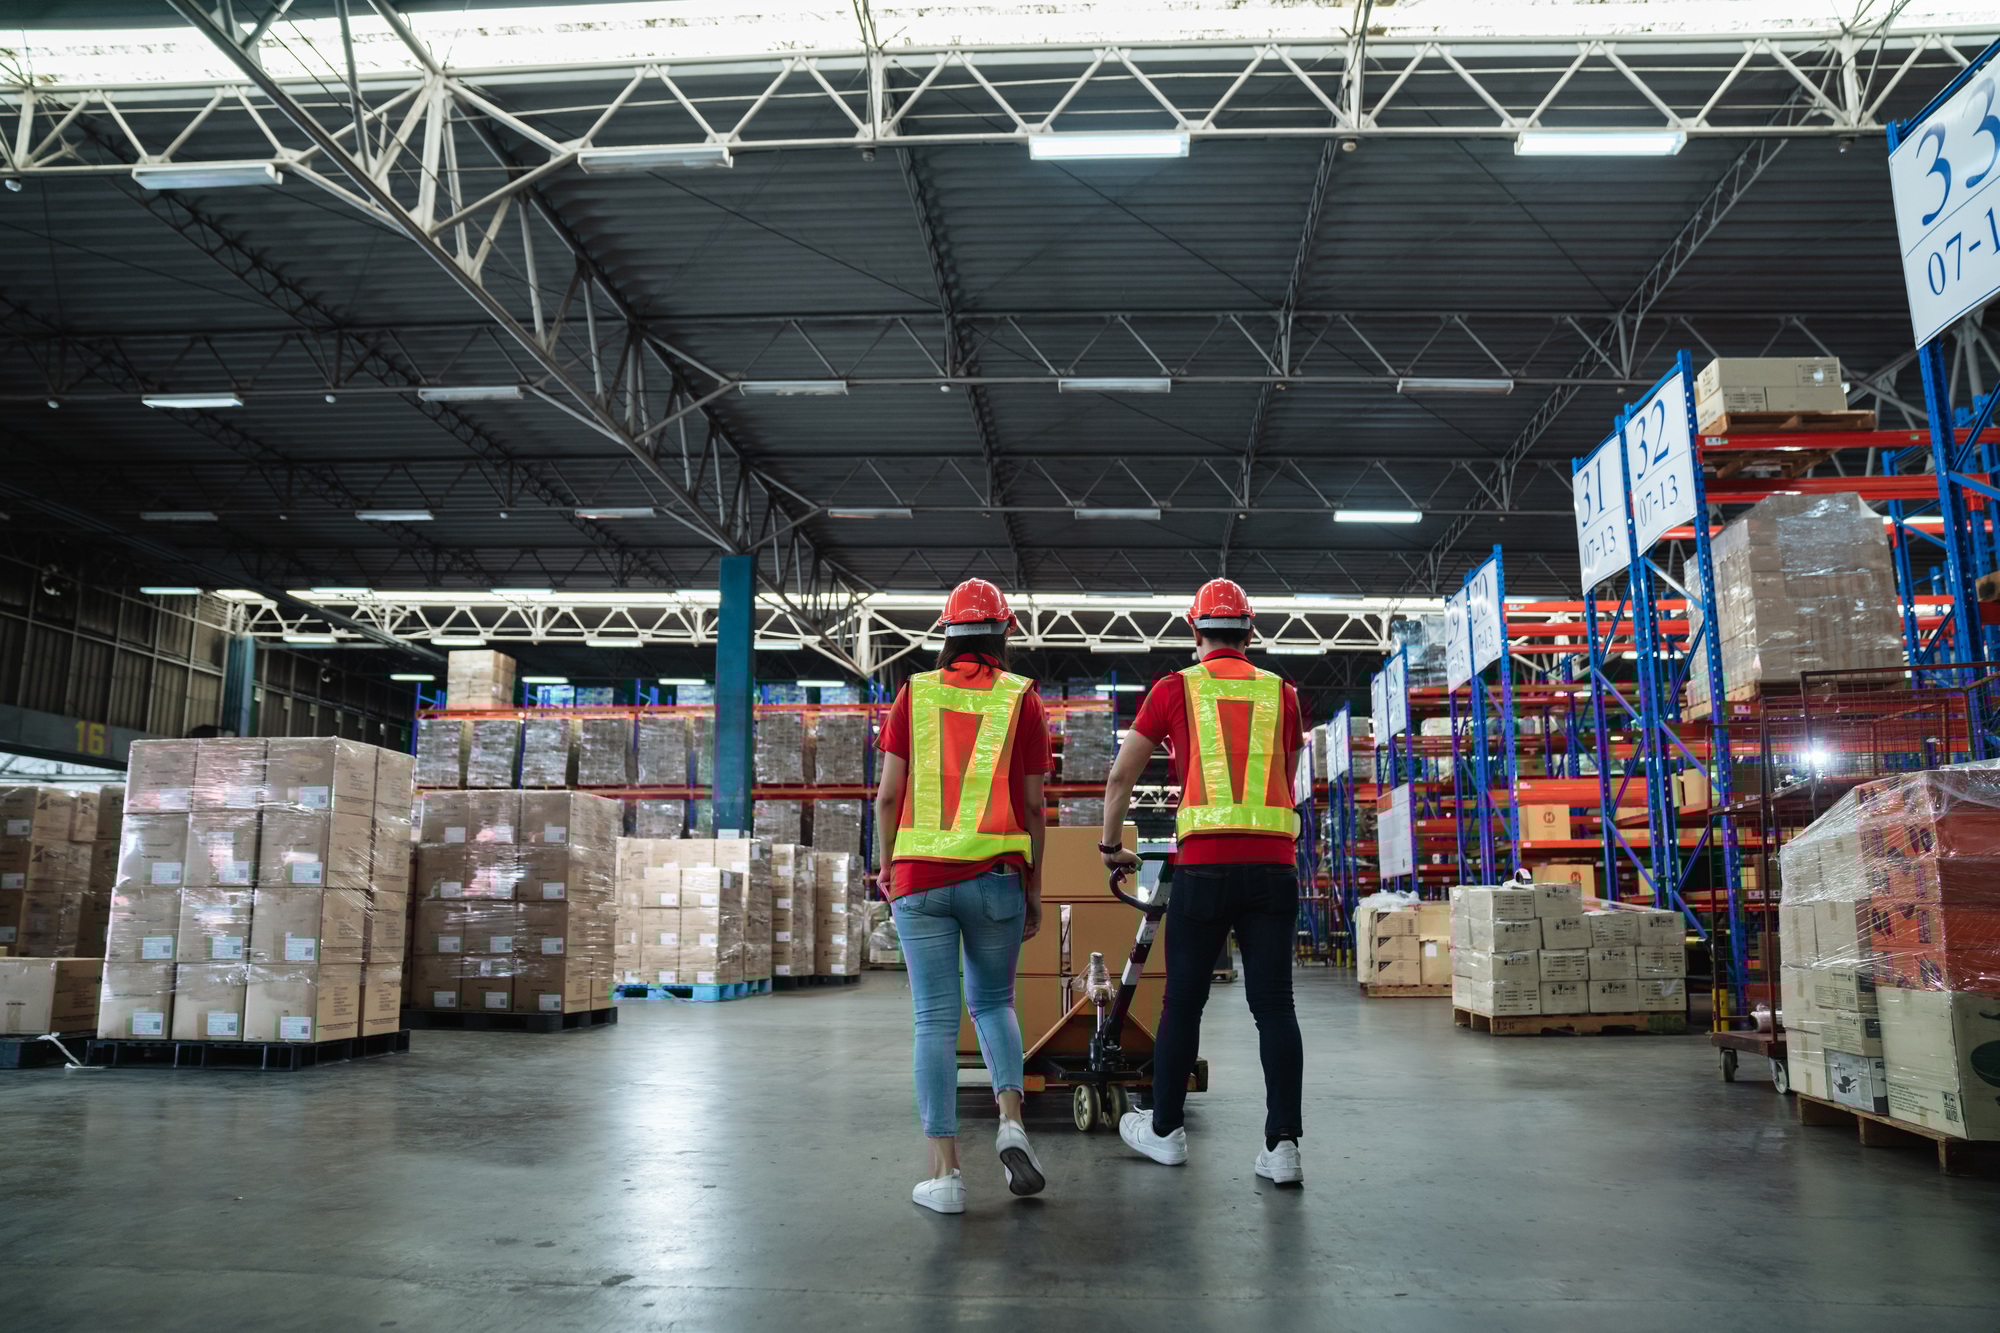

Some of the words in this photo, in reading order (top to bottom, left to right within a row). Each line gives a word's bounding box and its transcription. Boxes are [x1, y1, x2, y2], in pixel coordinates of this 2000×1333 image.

[1916, 77, 2000, 226] 33
[1634, 399, 1670, 480] 32
[1580, 457, 1606, 528] 31
[1639, 474, 1679, 527] 07-13
[1583, 525, 1617, 568] 07-13
[1473, 572, 1489, 625] 30
[75, 720, 105, 756] 16
